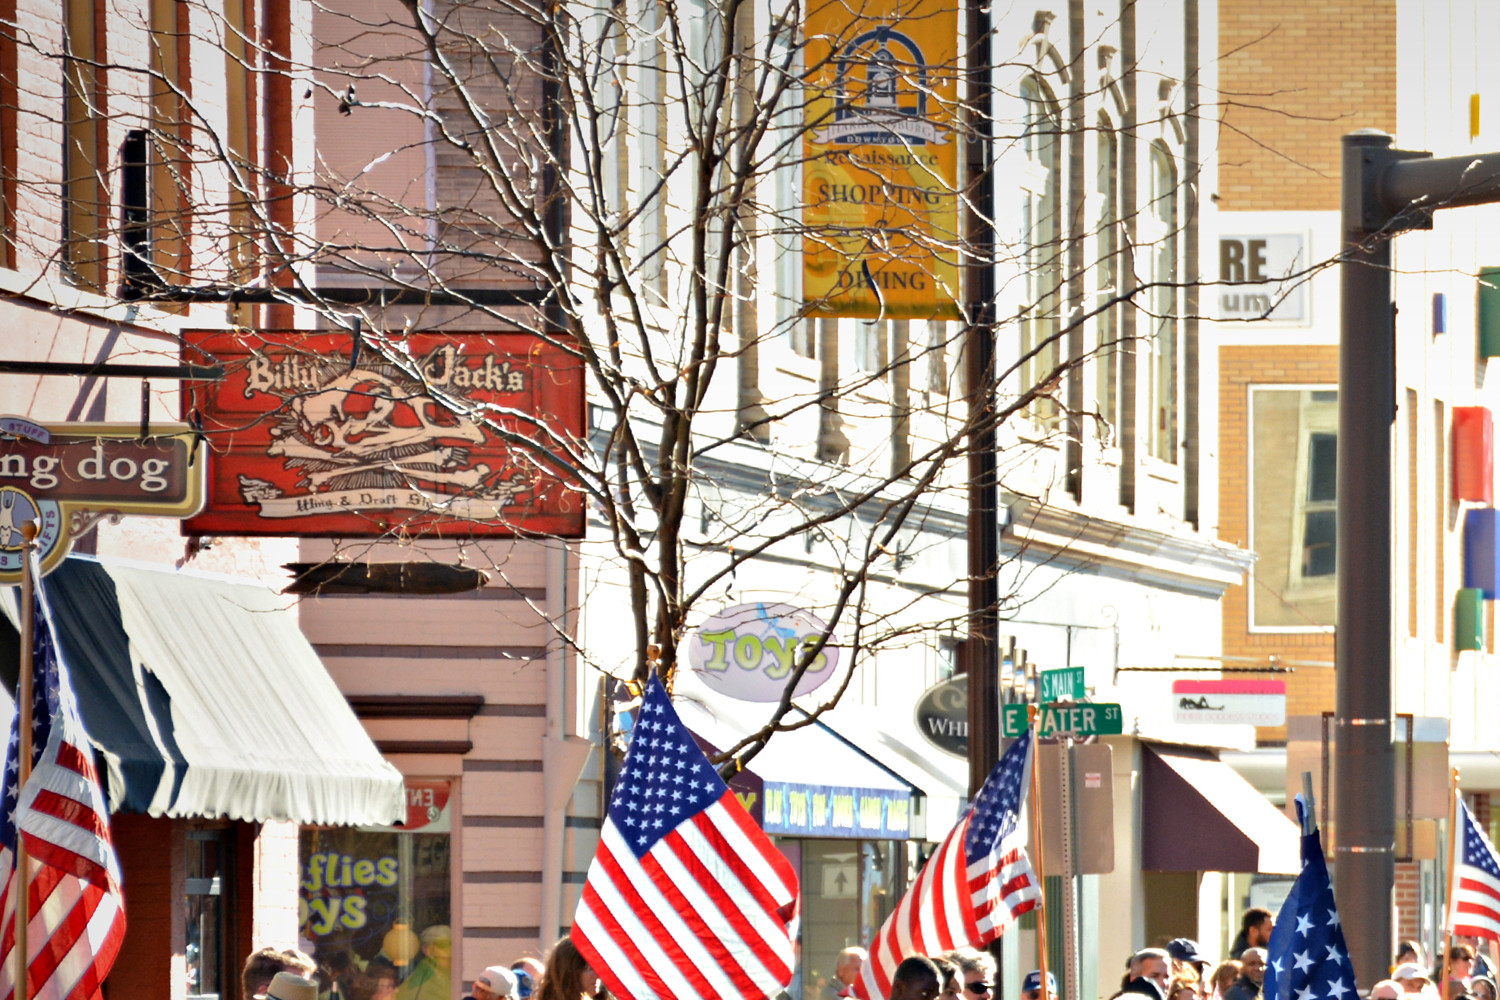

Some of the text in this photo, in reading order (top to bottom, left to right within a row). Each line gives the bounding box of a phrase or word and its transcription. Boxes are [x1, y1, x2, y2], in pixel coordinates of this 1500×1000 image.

[425, 344, 524, 391] Jack's
[8, 423, 46, 439] STUFF
[77, 446, 169, 491] dog
[340, 495, 350, 506] &
[359, 493, 398, 506] Draft
[1043, 670, 1083, 698] S MAIN ST
[1006, 710, 1018, 734] E
[1105, 709, 1119, 720] ST
[299, 852, 399, 892] flies
